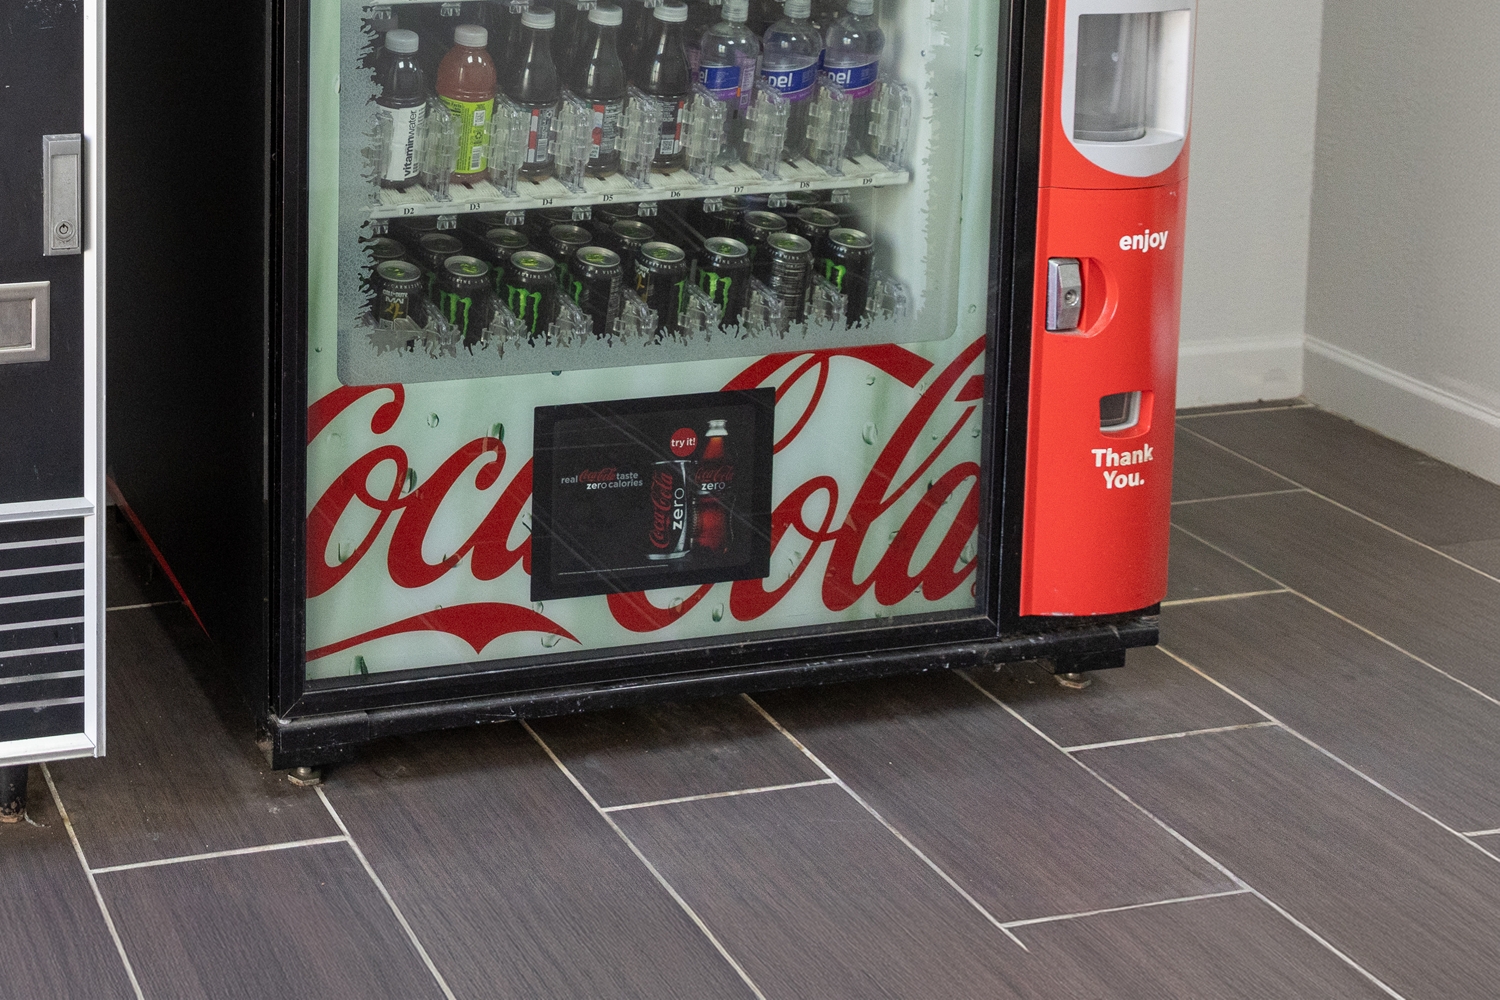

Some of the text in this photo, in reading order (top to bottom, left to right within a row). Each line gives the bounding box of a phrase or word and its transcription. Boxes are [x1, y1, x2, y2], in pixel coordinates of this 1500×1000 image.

[403, 110, 417, 177] vitaminwater
[1119, 229, 1168, 253] enjoy
[671, 437, 696, 448] try it!
[1091, 443, 1154, 468] Thank
[561, 475, 578, 484] real
[616, 471, 639, 480] taste
[586, 478, 643, 490] zero calories
[702, 481, 726, 491] zero
[1102, 470, 1146, 489] You.
[672, 487, 685, 530] zero
